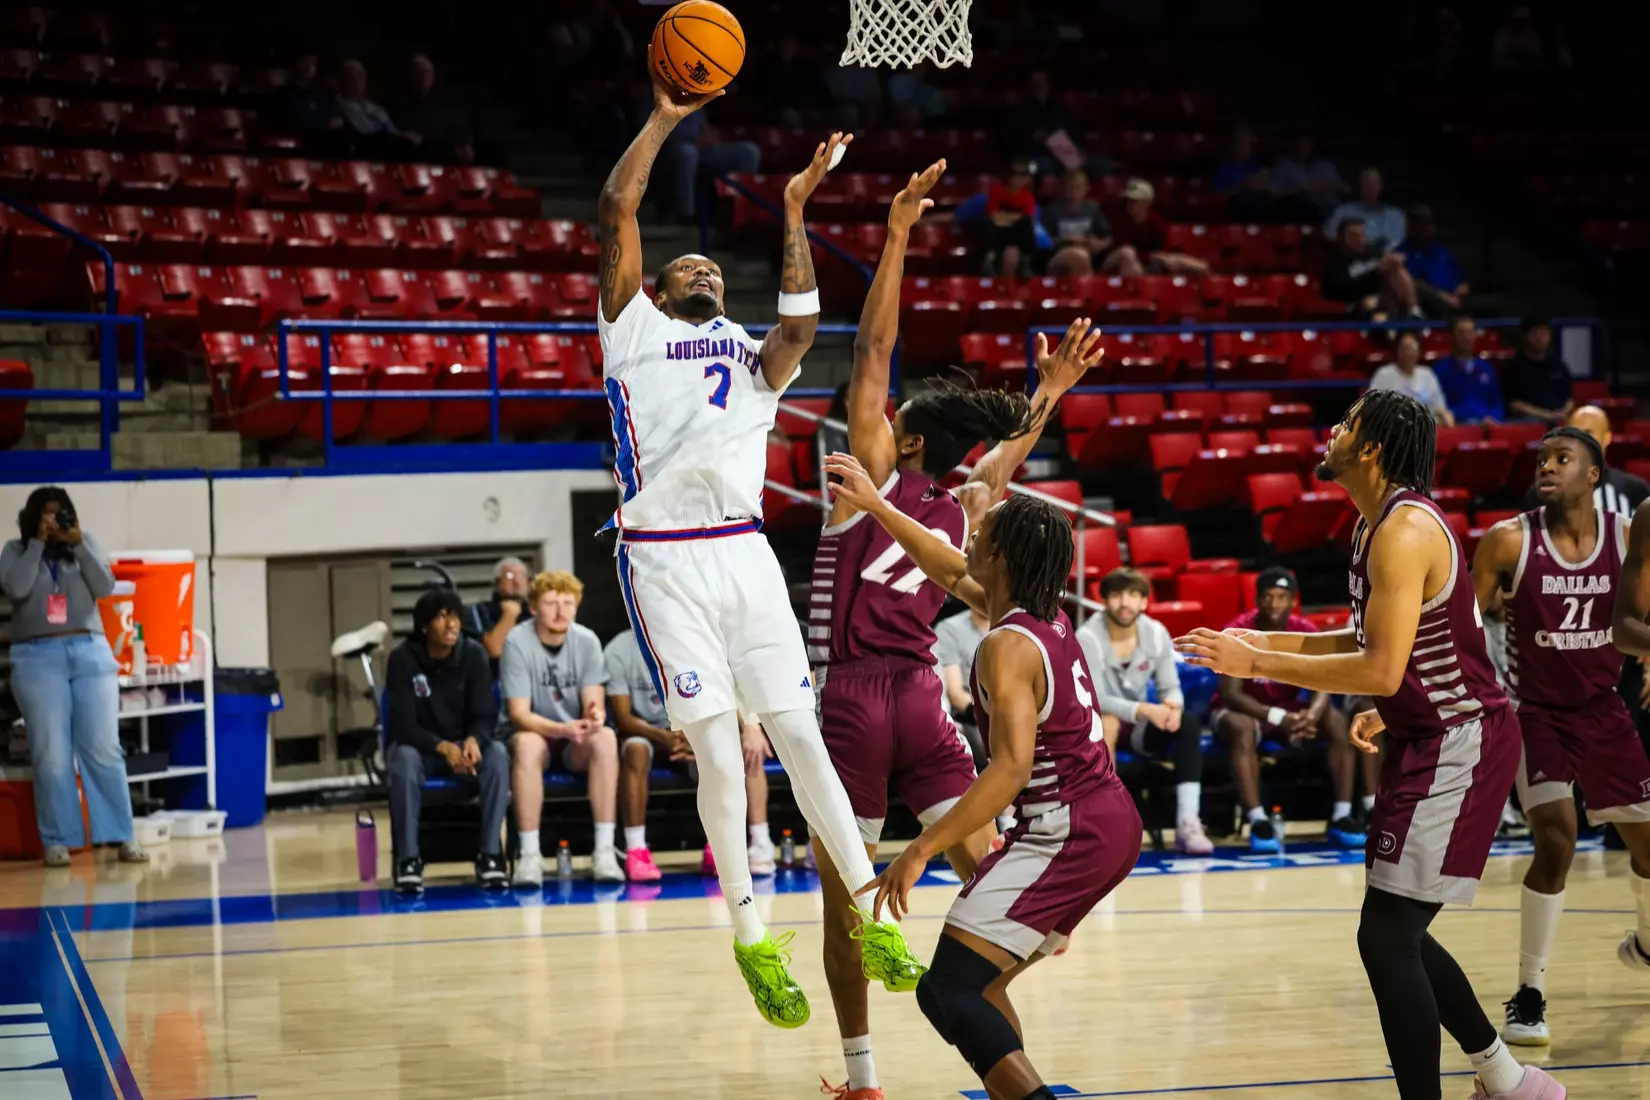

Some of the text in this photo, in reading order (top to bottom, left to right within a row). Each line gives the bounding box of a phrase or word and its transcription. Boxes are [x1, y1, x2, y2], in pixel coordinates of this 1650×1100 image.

[666, 338, 735, 360] LOUISIANA
[703, 362, 732, 411] 7
[1541, 574, 1612, 595] DALLAS
[1558, 596, 1595, 630] 21
